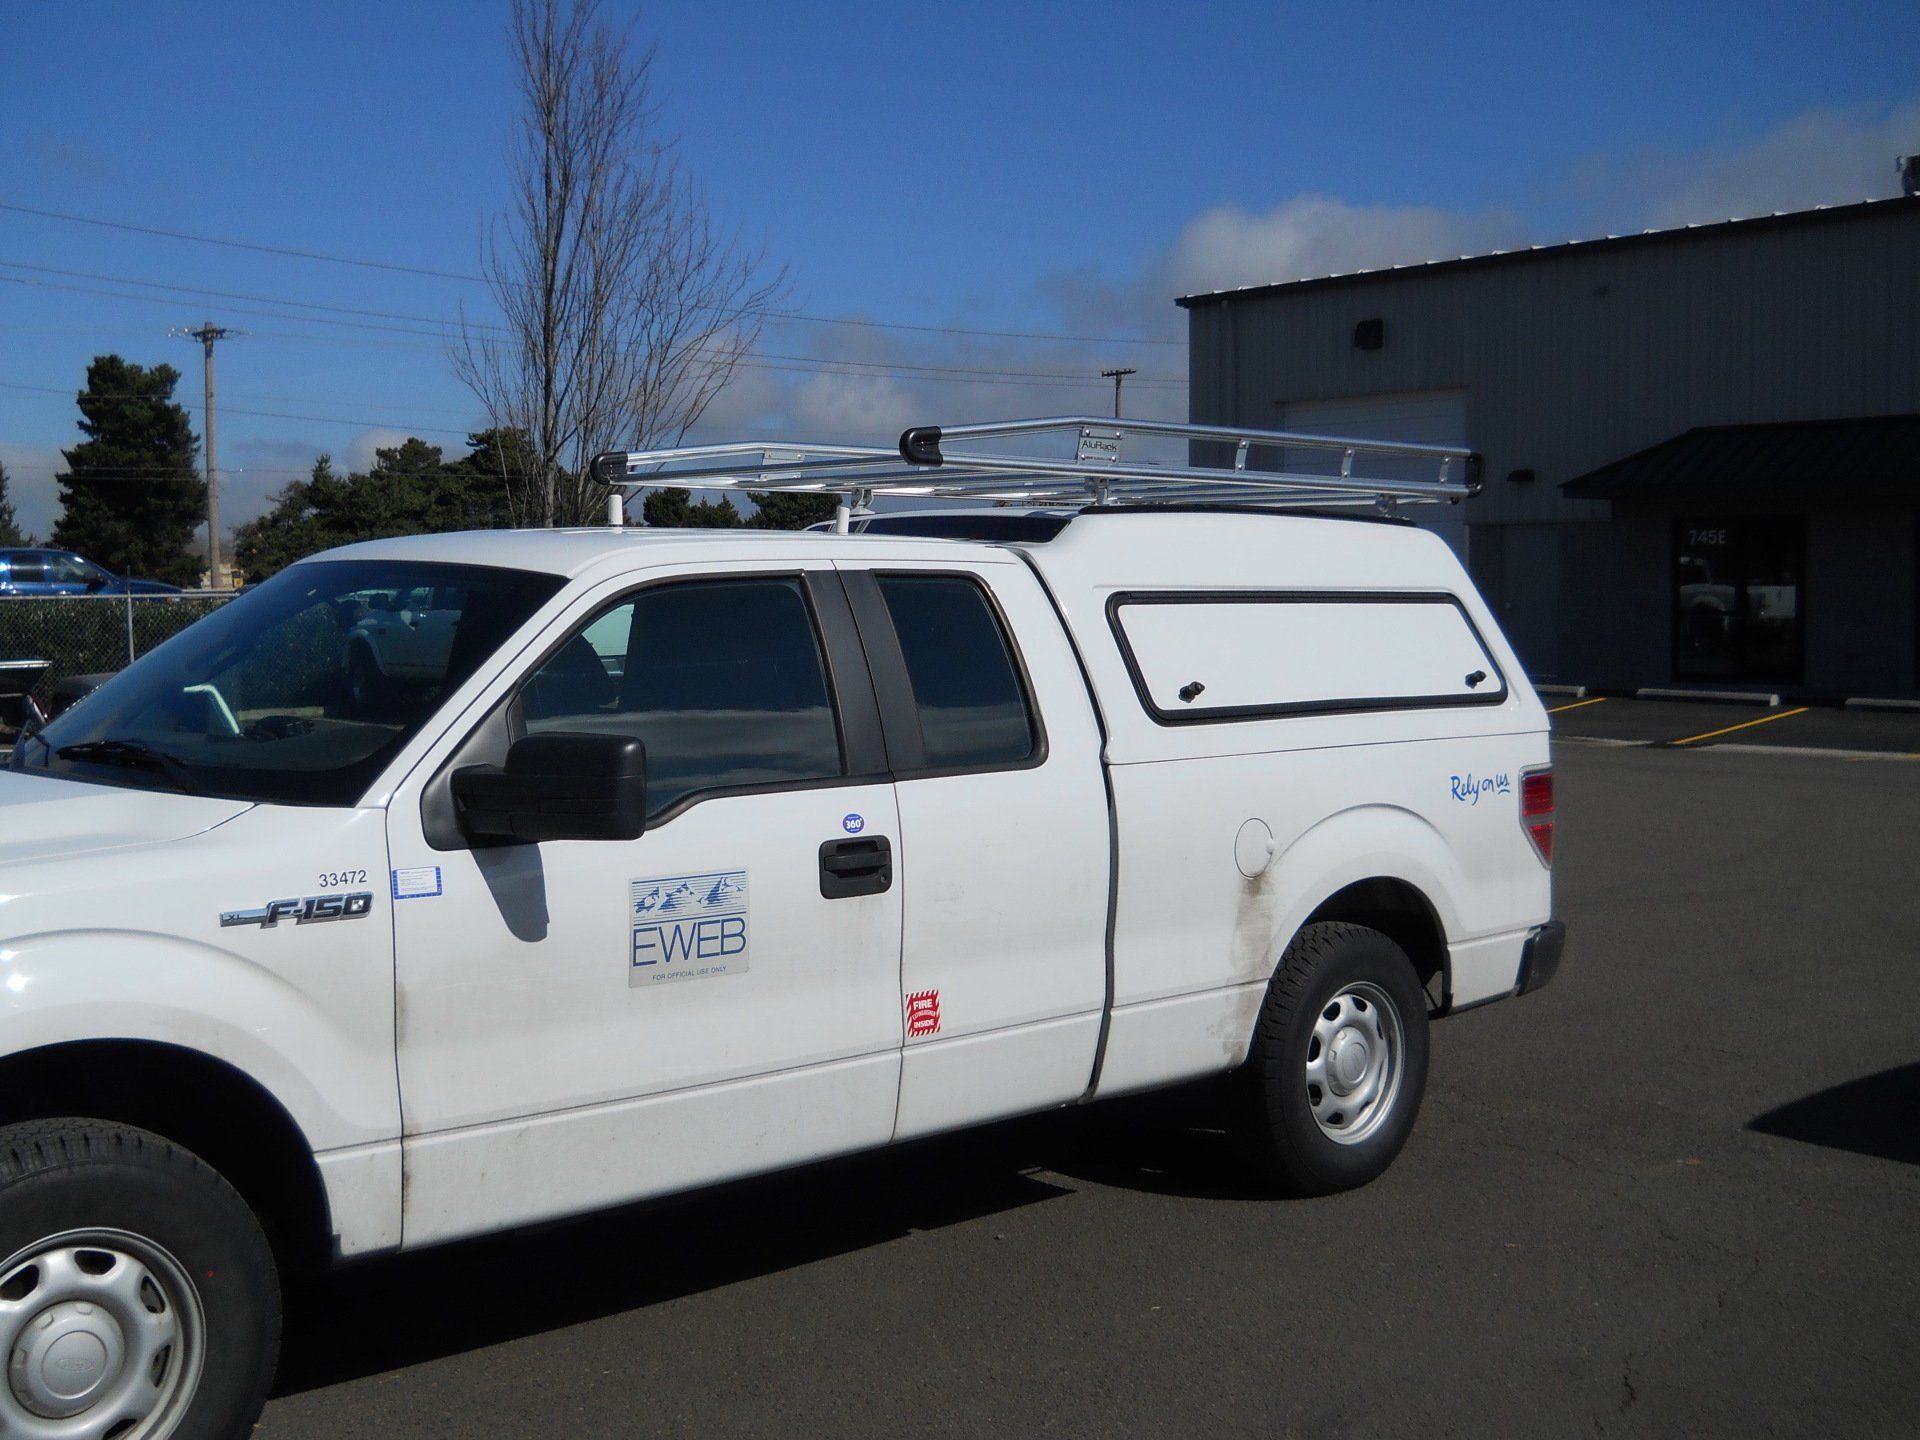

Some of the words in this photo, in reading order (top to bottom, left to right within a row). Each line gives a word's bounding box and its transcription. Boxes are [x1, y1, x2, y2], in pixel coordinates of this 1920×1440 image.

[1689, 530, 1727, 544] 745E
[1451, 773, 1480, 806] Rely
[1482, 779, 1494, 792] on
[319, 870, 367, 887] 33472
[260, 891, 373, 929] F-150
[633, 917, 746, 967] EWEB
[667, 970, 695, 980] OFFICIAL
[696, 968, 710, 976] USE
[711, 966, 727, 974] ONLY
[913, 999, 933, 1010] FIRE
